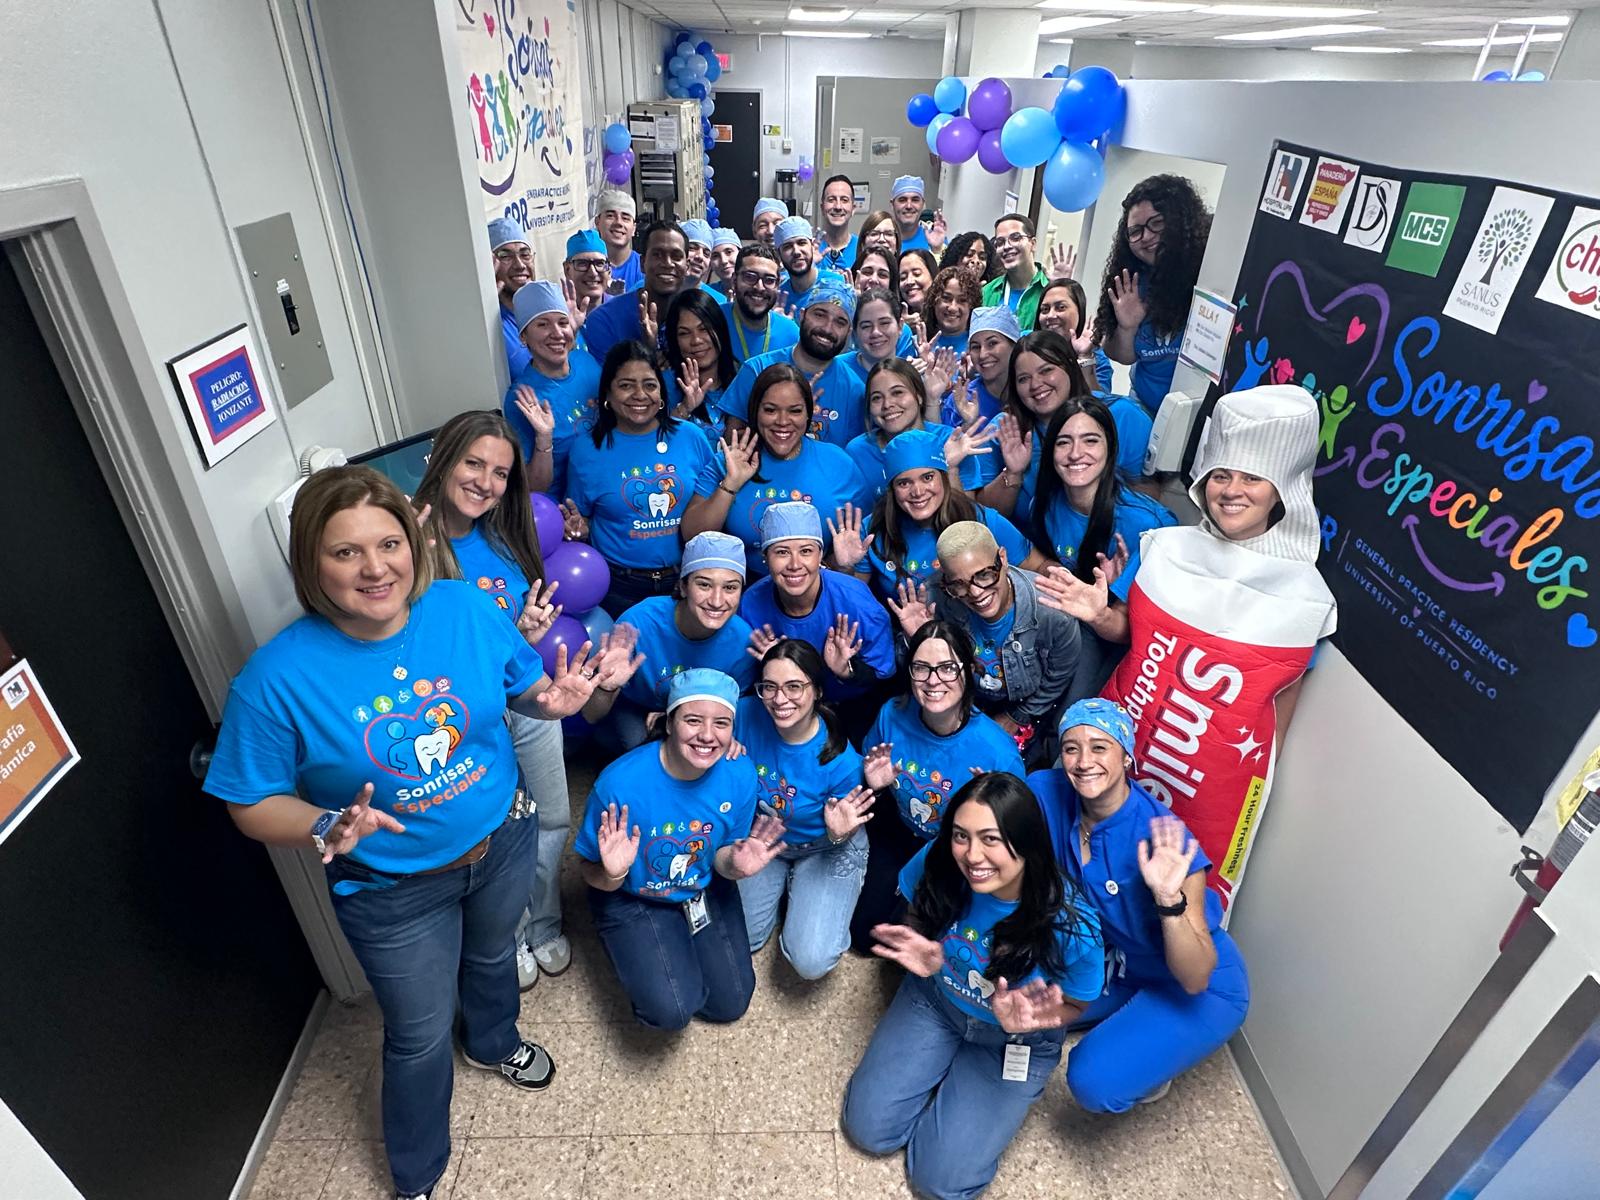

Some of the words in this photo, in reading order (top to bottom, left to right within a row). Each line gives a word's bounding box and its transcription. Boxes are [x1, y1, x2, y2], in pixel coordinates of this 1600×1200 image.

[1313, 185, 1339, 199] ESPAÑA
[1403, 214, 1446, 243] MCS
[1566, 235, 1600, 276] ch
[1456, 297, 1479, 311] PUERTO
[1480, 308, 1496, 317] RICO
[1461, 282, 1501, 308] SANUS
[210, 371, 243, 394] PELIGRO:
[218, 394, 254, 422] IONIZANTE
[633, 517, 681, 529] Sonrisas
[1357, 423, 1588, 609] Especiales
[1355, 538, 1395, 578] GENERAL
[1398, 575, 1447, 621] PRACTICE
[1449, 618, 1519, 676] RESIDENCY
[1344, 562, 1398, 616] UNIVERSITY
[1400, 615, 1416, 629] OF
[1416, 629, 1460, 671] PUERTO
[1463, 670, 1497, 700] RICO
[1124, 631, 1178, 733] Toothp
[0, 723, 26, 750] afía
[0, 740, 36, 782] ámica
[392, 764, 488, 813] Especiales
[396, 756, 474, 801] Sonrisas
[1252, 783, 1262, 797] 24
[1244, 800, 1257, 825] Hour
[1226, 826, 1249, 875] Freshness
